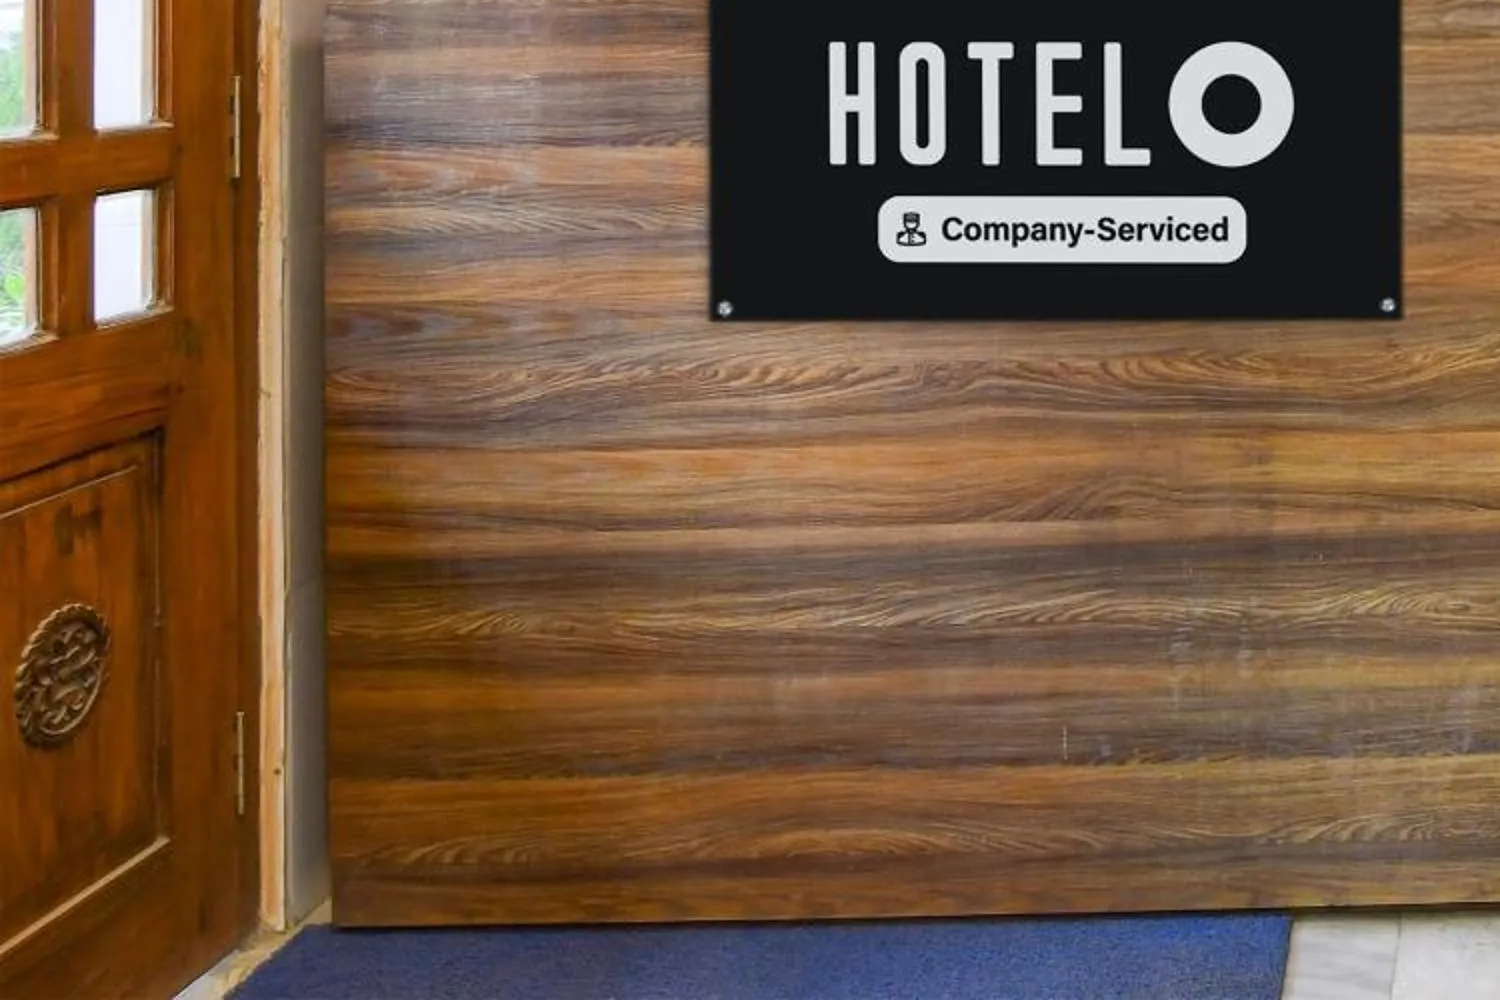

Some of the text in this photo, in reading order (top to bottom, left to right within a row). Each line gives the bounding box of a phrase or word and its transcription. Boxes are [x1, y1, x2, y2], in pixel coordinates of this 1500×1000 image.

[828, 41, 1295, 167] HOTEL O
[941, 215, 1229, 248] Company-Serviced
